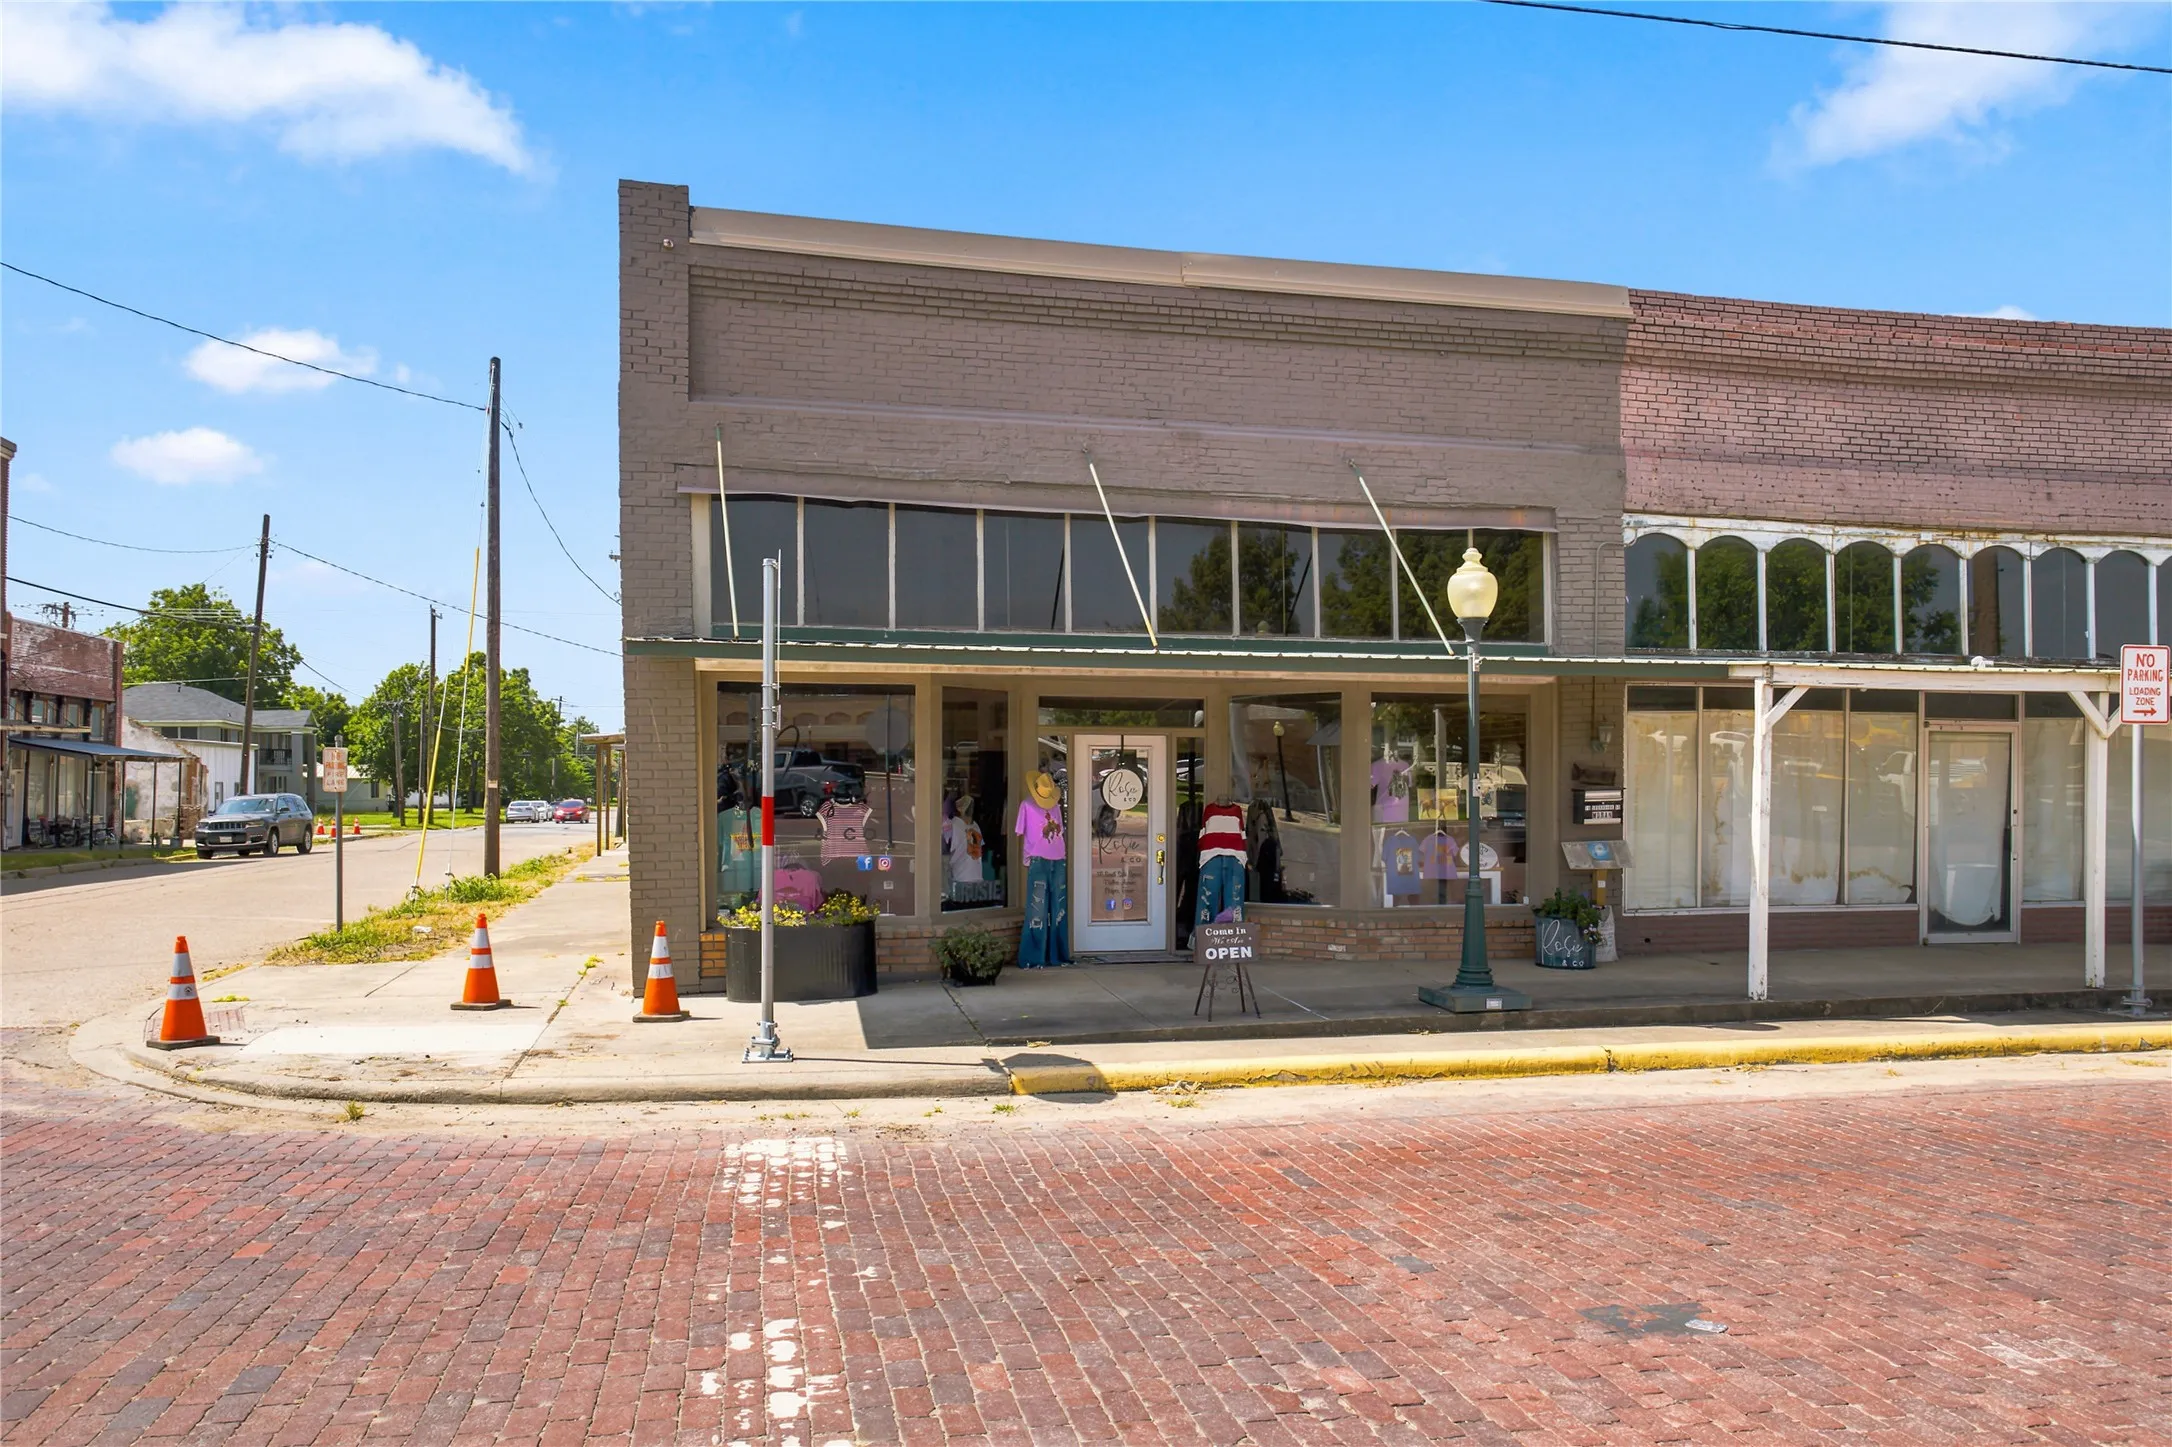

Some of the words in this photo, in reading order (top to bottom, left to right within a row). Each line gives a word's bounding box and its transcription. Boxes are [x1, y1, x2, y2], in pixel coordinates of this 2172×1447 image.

[2136, 653, 2155, 668] NO
[2127, 669, 2164, 682] PARKING
[2129, 687, 2161, 696] LOADING
[2136, 697, 2155, 706] ZONE
[1205, 928, 1234, 936] Come
[1236, 926, 1246, 935] In
[1205, 946, 1252, 960] OPEN
